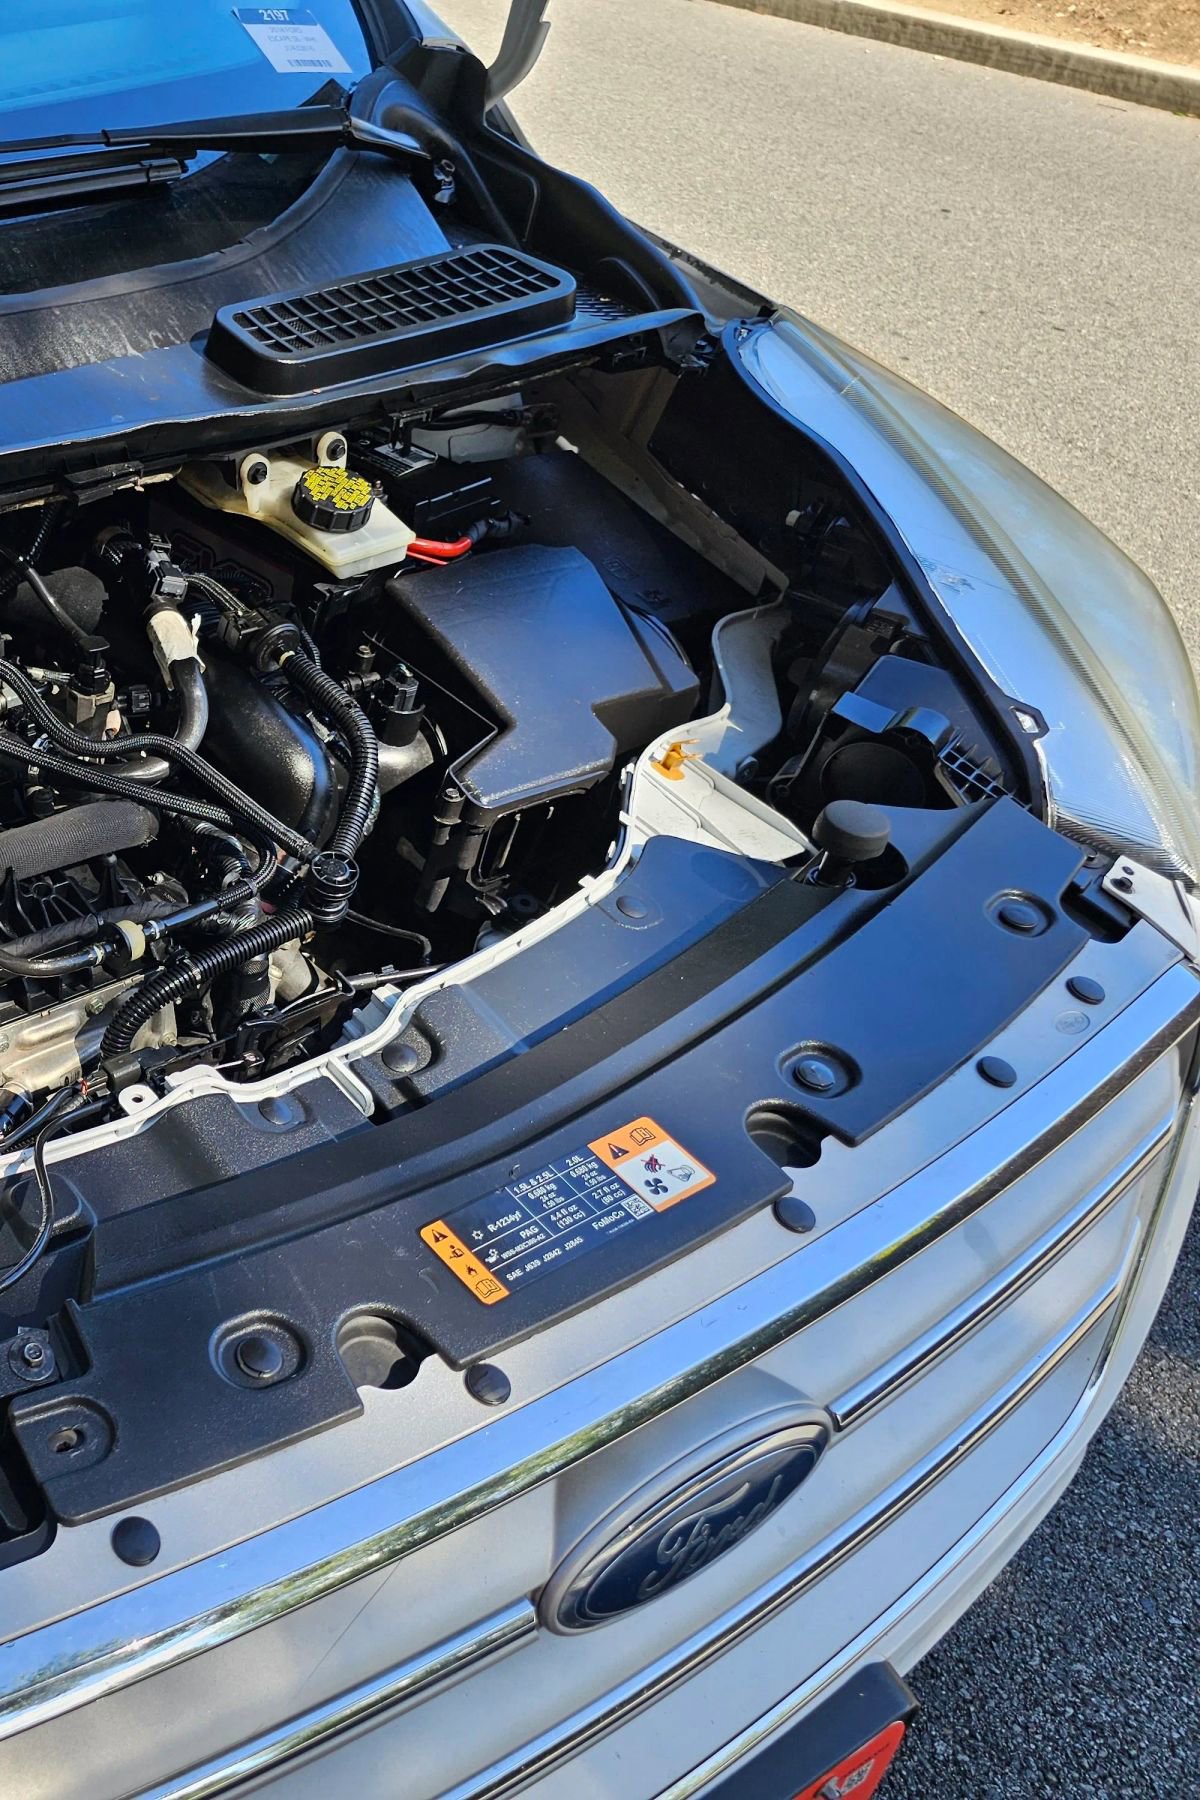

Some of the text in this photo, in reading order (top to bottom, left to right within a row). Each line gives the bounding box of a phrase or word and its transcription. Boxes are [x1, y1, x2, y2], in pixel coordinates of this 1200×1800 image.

[259, 9, 290, 21] 2197
[566, 1155, 584, 1167] 2.0L
[570, 1161, 599, 1178] 0.680 kg
[513, 1171, 554, 1194] 1.5L & 2.5L
[582, 1173, 591, 1181] 24
[595, 1174, 607, 1182] lbs
[528, 1183, 558, 1200] 0.680 kg
[540, 1194, 549, 1203] 24
[592, 1182, 620, 1199] 2.7 fl oz
[613, 1188, 626, 1198] cc)
[554, 1196, 565, 1204] lbs
[550, 1204, 578, 1221] 4.4 fl oz
[557, 1210, 586, 1229] (130 cc)
[592, 1210, 625, 1230] FoMoCo
[487, 1211, 522, 1233] R-1234yf
[519, 1225, 539, 1239] PAG
[506, 1236, 584, 1281] SAE J639 J2842 J2845
[637, 1474, 784, 1600] Ford
